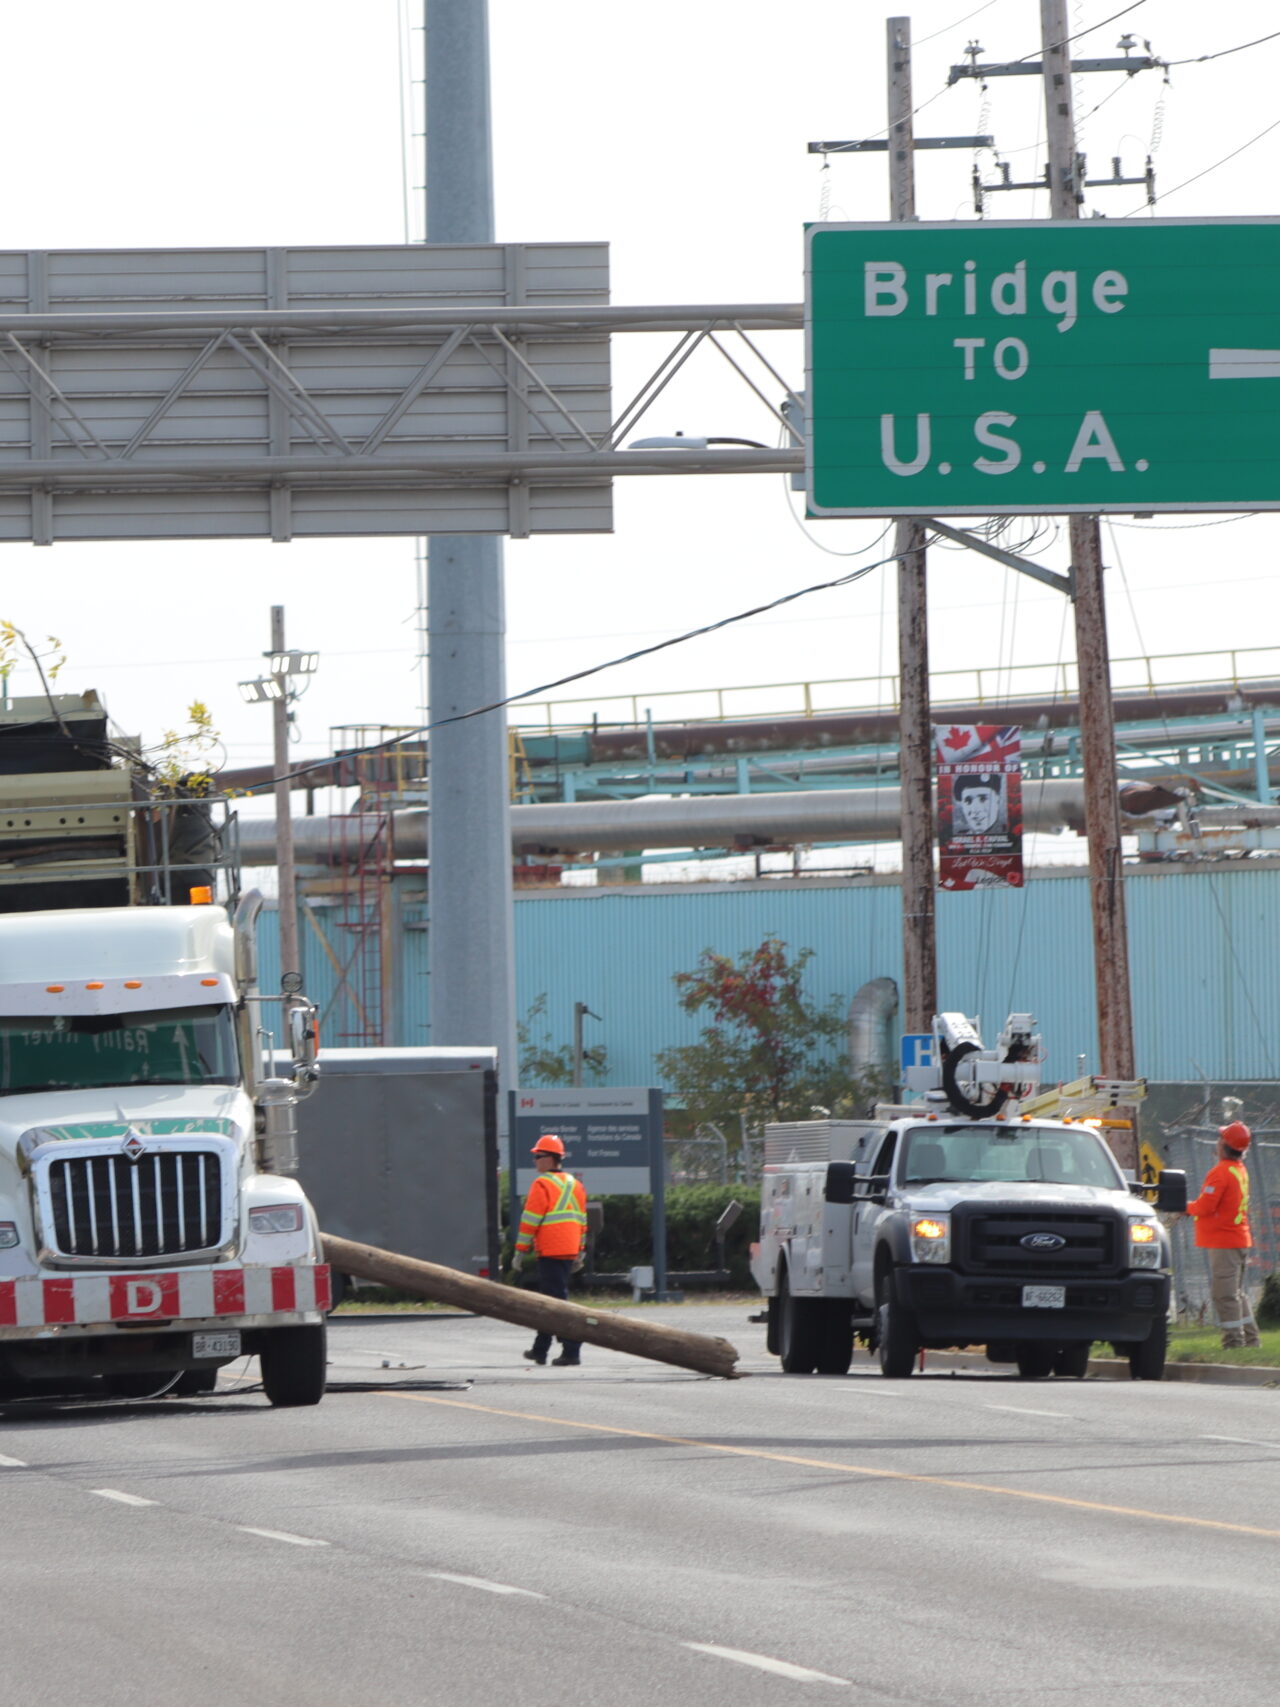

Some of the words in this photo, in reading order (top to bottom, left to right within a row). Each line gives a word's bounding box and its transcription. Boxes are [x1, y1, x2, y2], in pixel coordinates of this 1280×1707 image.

[864, 260, 1128, 333] Bridge
[953, 336, 1029, 380] TO
[880, 410, 1149, 476] U.S.A.
[939, 764, 951, 774] IN
[955, 763, 1001, 773] HONOUR
[1005, 763, 1018, 772] OF
[914, 1039, 936, 1067] H
[1031, 1234, 1055, 1247] Ford
[127, 1280, 162, 1314] D
